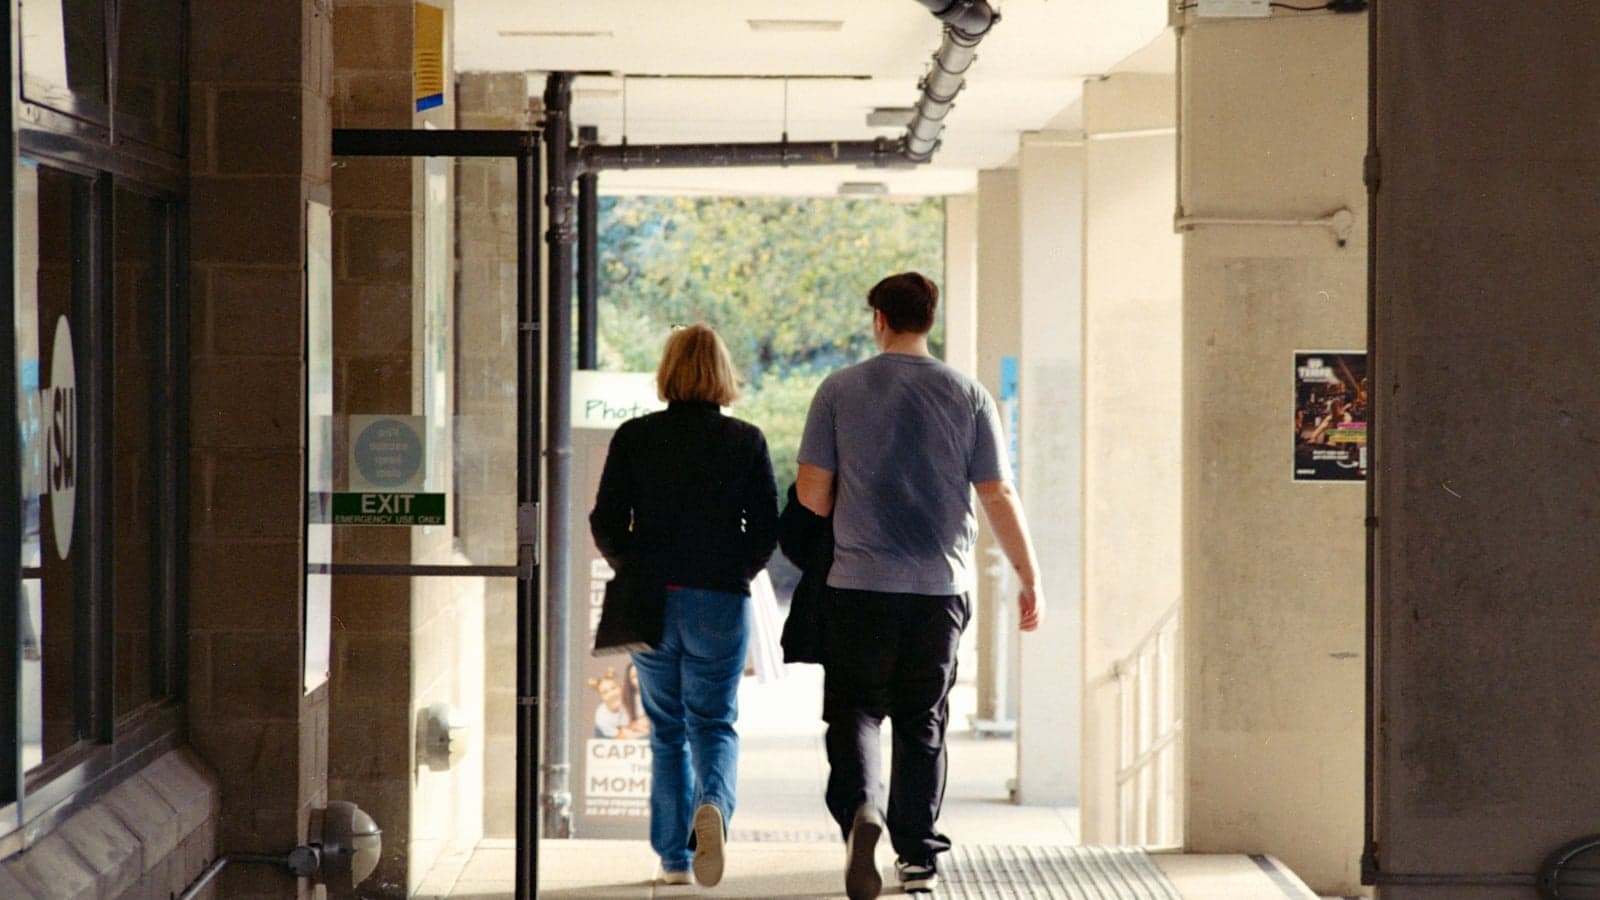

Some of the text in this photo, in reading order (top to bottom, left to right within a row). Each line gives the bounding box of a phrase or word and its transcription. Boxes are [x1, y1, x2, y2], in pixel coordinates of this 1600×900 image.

[361, 494, 415, 514] EXIT
[335, 515, 440, 524] EMERGENCY USE ONLY
